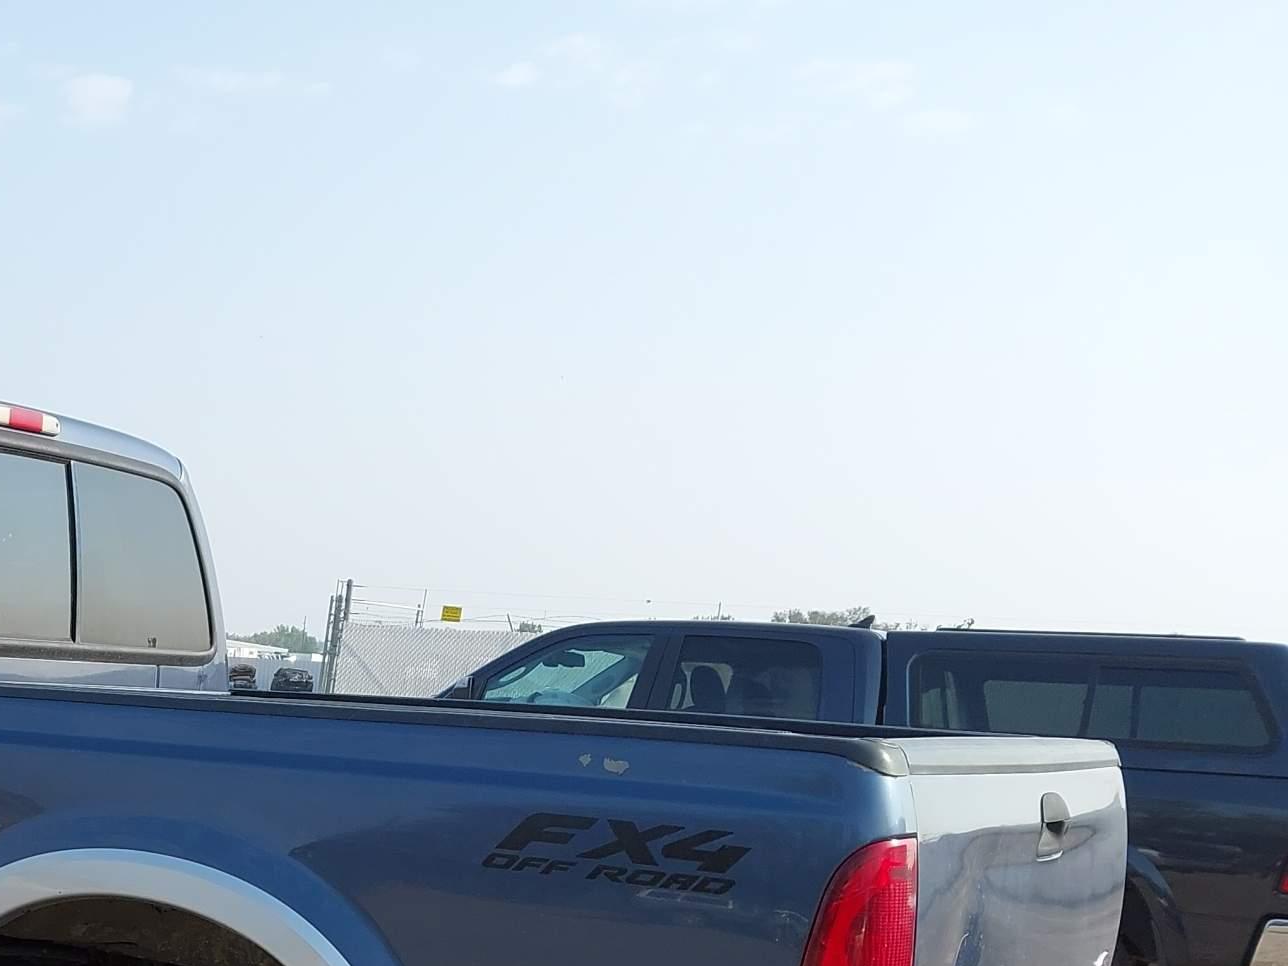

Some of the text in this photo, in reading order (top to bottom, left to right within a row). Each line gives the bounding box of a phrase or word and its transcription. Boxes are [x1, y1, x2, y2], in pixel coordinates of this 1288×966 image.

[495, 812, 752, 873] FX4
[481, 852, 737, 895] OFF ROAD
